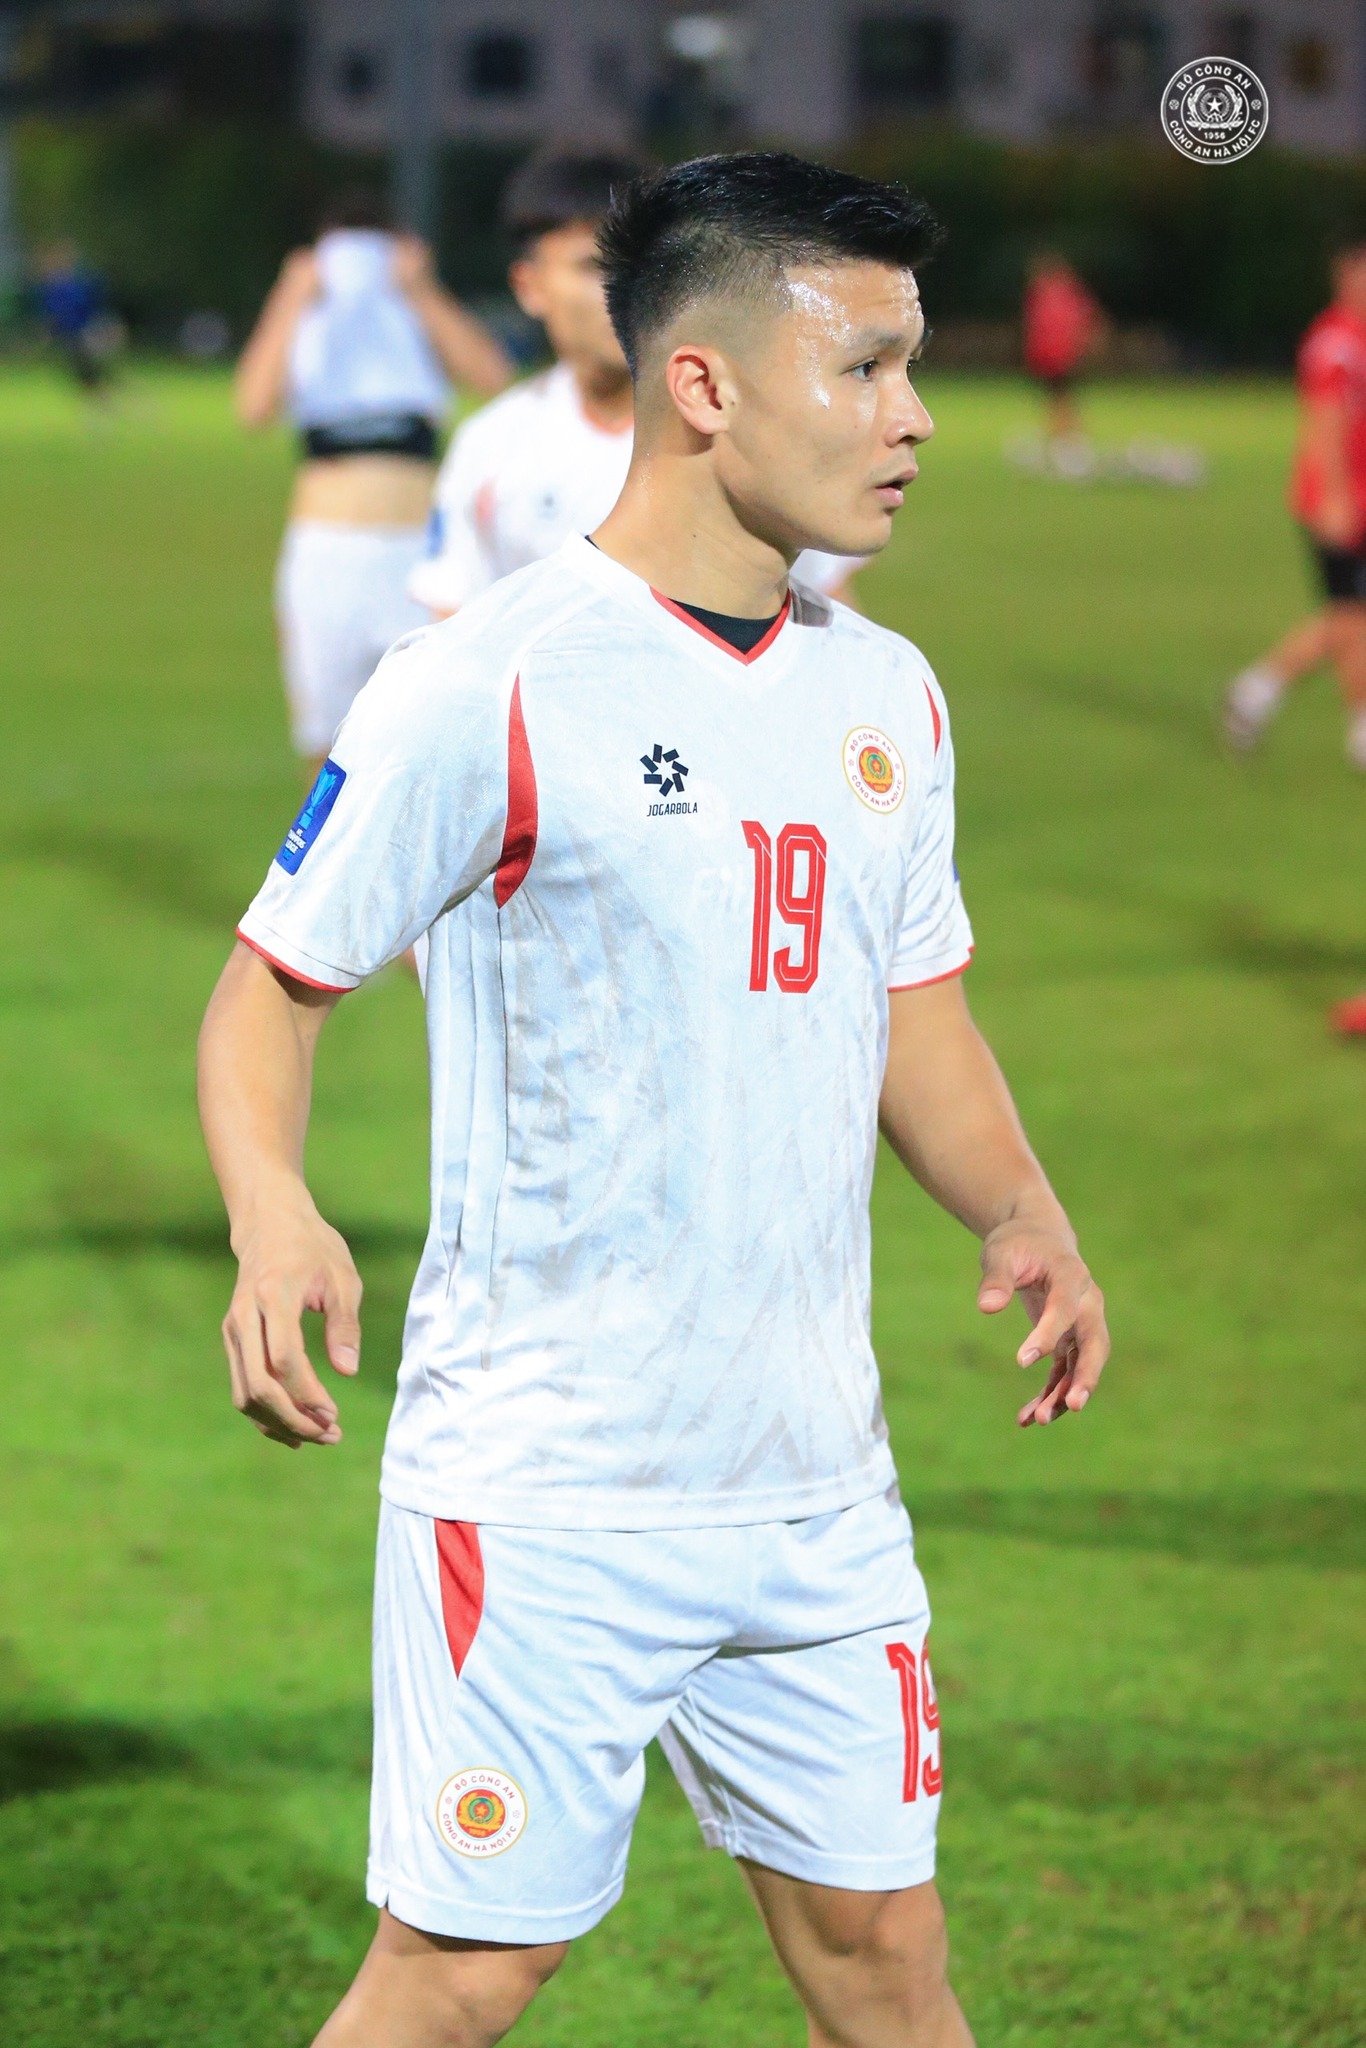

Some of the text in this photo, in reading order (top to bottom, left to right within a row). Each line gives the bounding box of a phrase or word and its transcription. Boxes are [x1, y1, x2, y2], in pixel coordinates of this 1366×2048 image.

[881, 741, 892, 753] AN
[870, 797, 880, 806] AN
[646, 802, 698, 817] JOGARBOLA
[741, 820, 827, 993] 19
[502, 1786, 515, 1799] AN
[457, 1839, 472, 1850] AN
